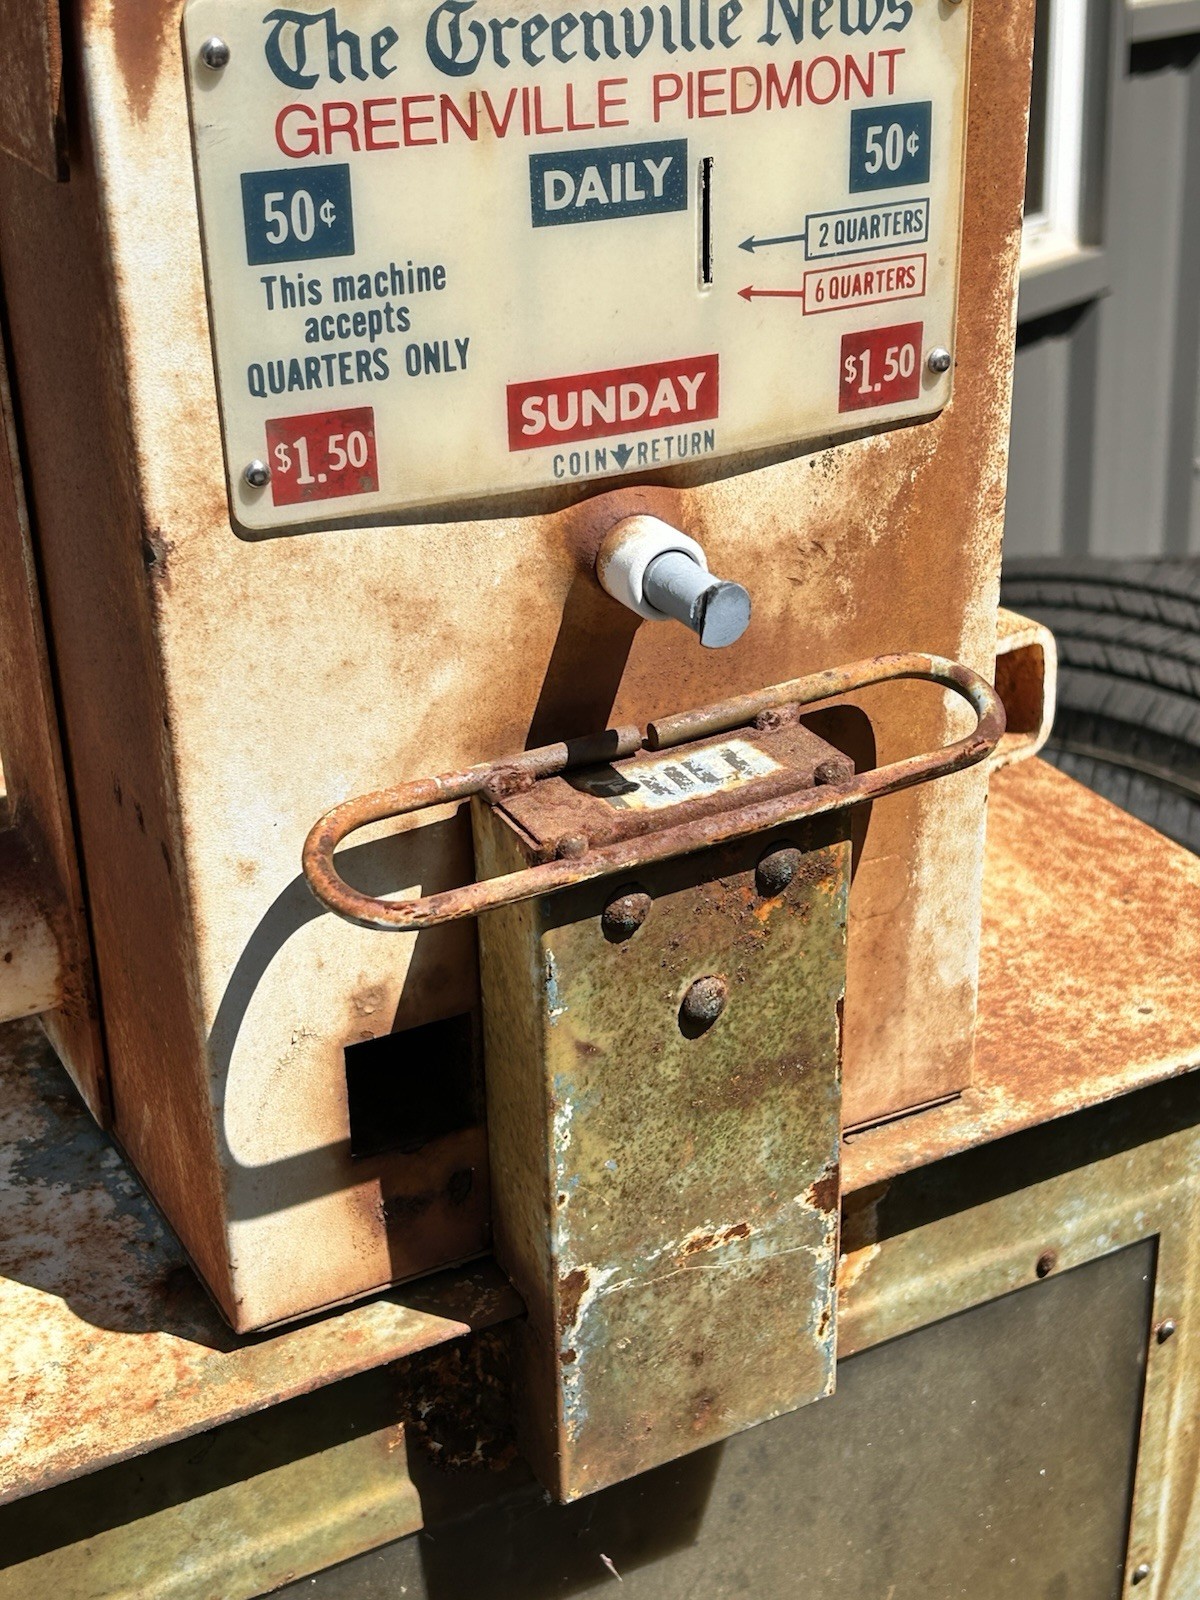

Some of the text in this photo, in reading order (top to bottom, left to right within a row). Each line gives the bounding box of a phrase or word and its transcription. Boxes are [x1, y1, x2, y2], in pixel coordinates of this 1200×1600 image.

[262, 0, 914, 90] The Greenville News
[275, 48, 906, 158] GREENVILLE PIEDMONT
[864, 123, 920, 174] 50¢
[543, 156, 674, 211] DAILY
[264, 189, 337, 245] 50¢
[818, 209, 923, 248] 2 QUARTERS
[260, 260, 447, 310] This machine
[815, 266, 916, 302] 6 QUARTERS
[304, 302, 411, 343] accepts
[247, 337, 470, 398] QUARTERS ONLY
[844, 343, 915, 395] $1.50
[521, 372, 707, 436] SUNDAY
[274, 430, 369, 485] $1.50
[553, 429, 716, 478] COIN RETURN
